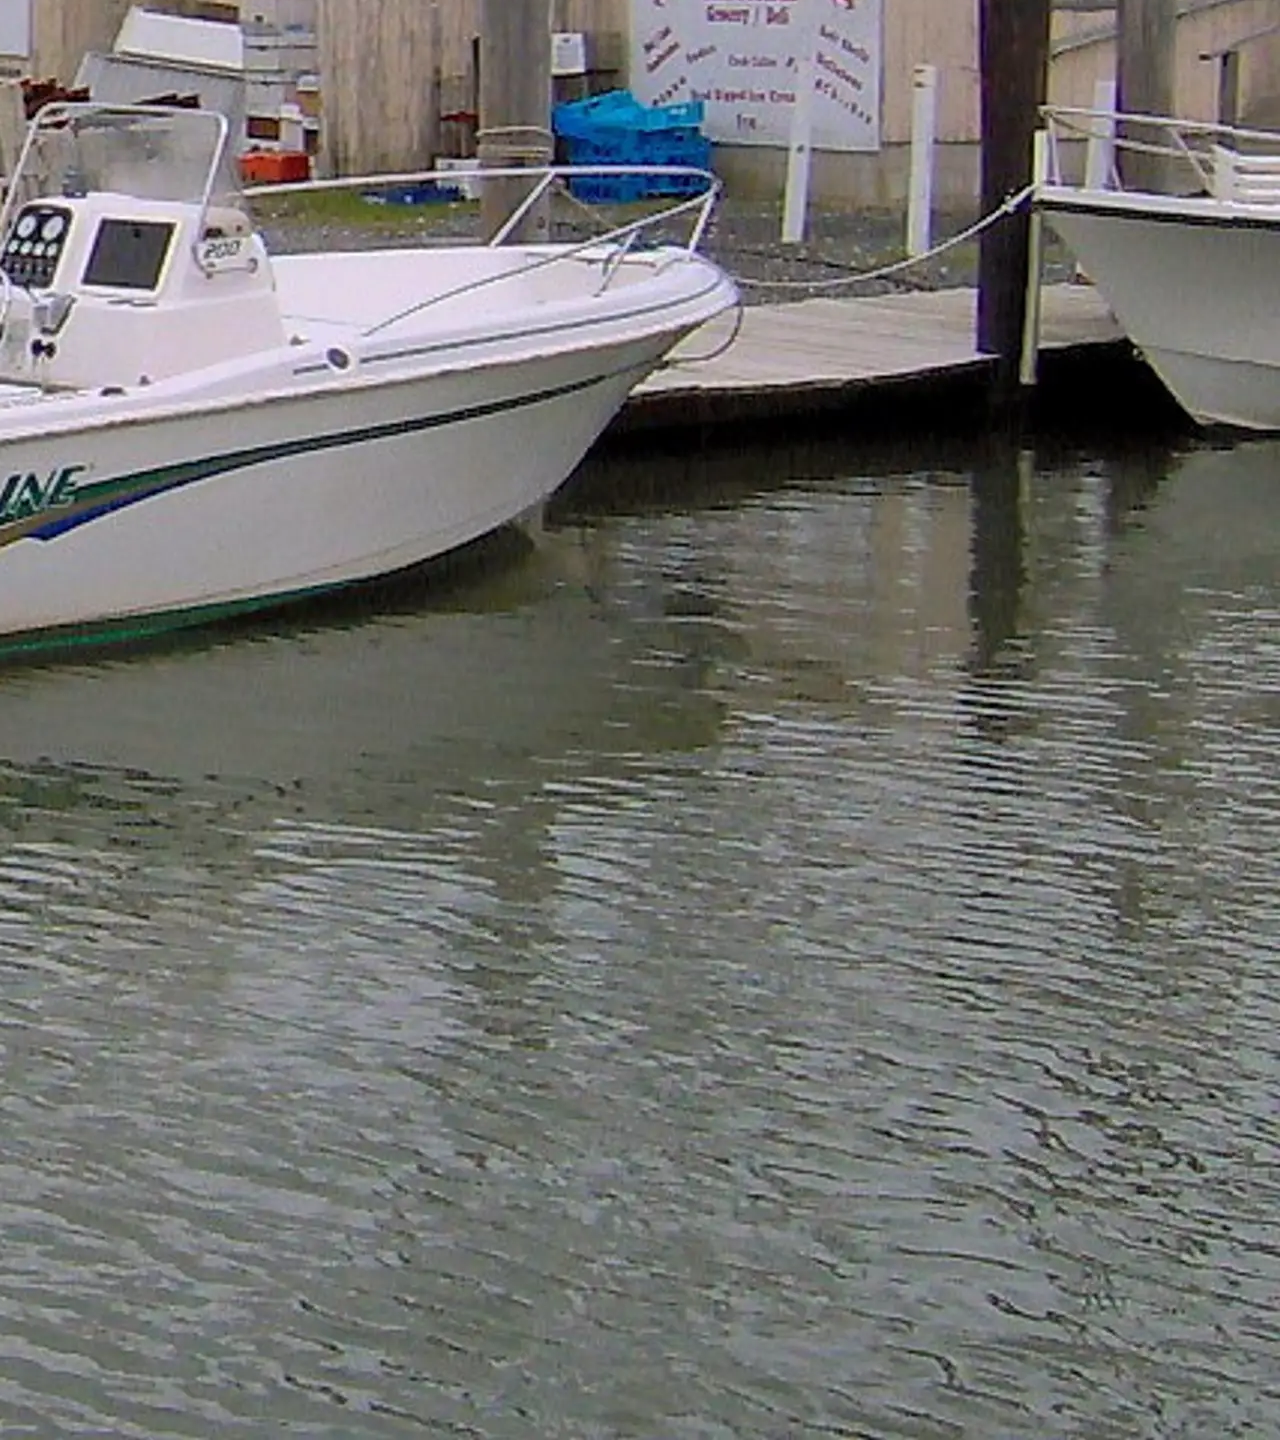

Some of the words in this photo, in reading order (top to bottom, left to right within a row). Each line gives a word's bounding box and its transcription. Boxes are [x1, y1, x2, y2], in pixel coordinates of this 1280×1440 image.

[706, 6, 750, 25] Grocery
[766, 6, 790, 25] Deli
[203, 240, 241, 259] 200
